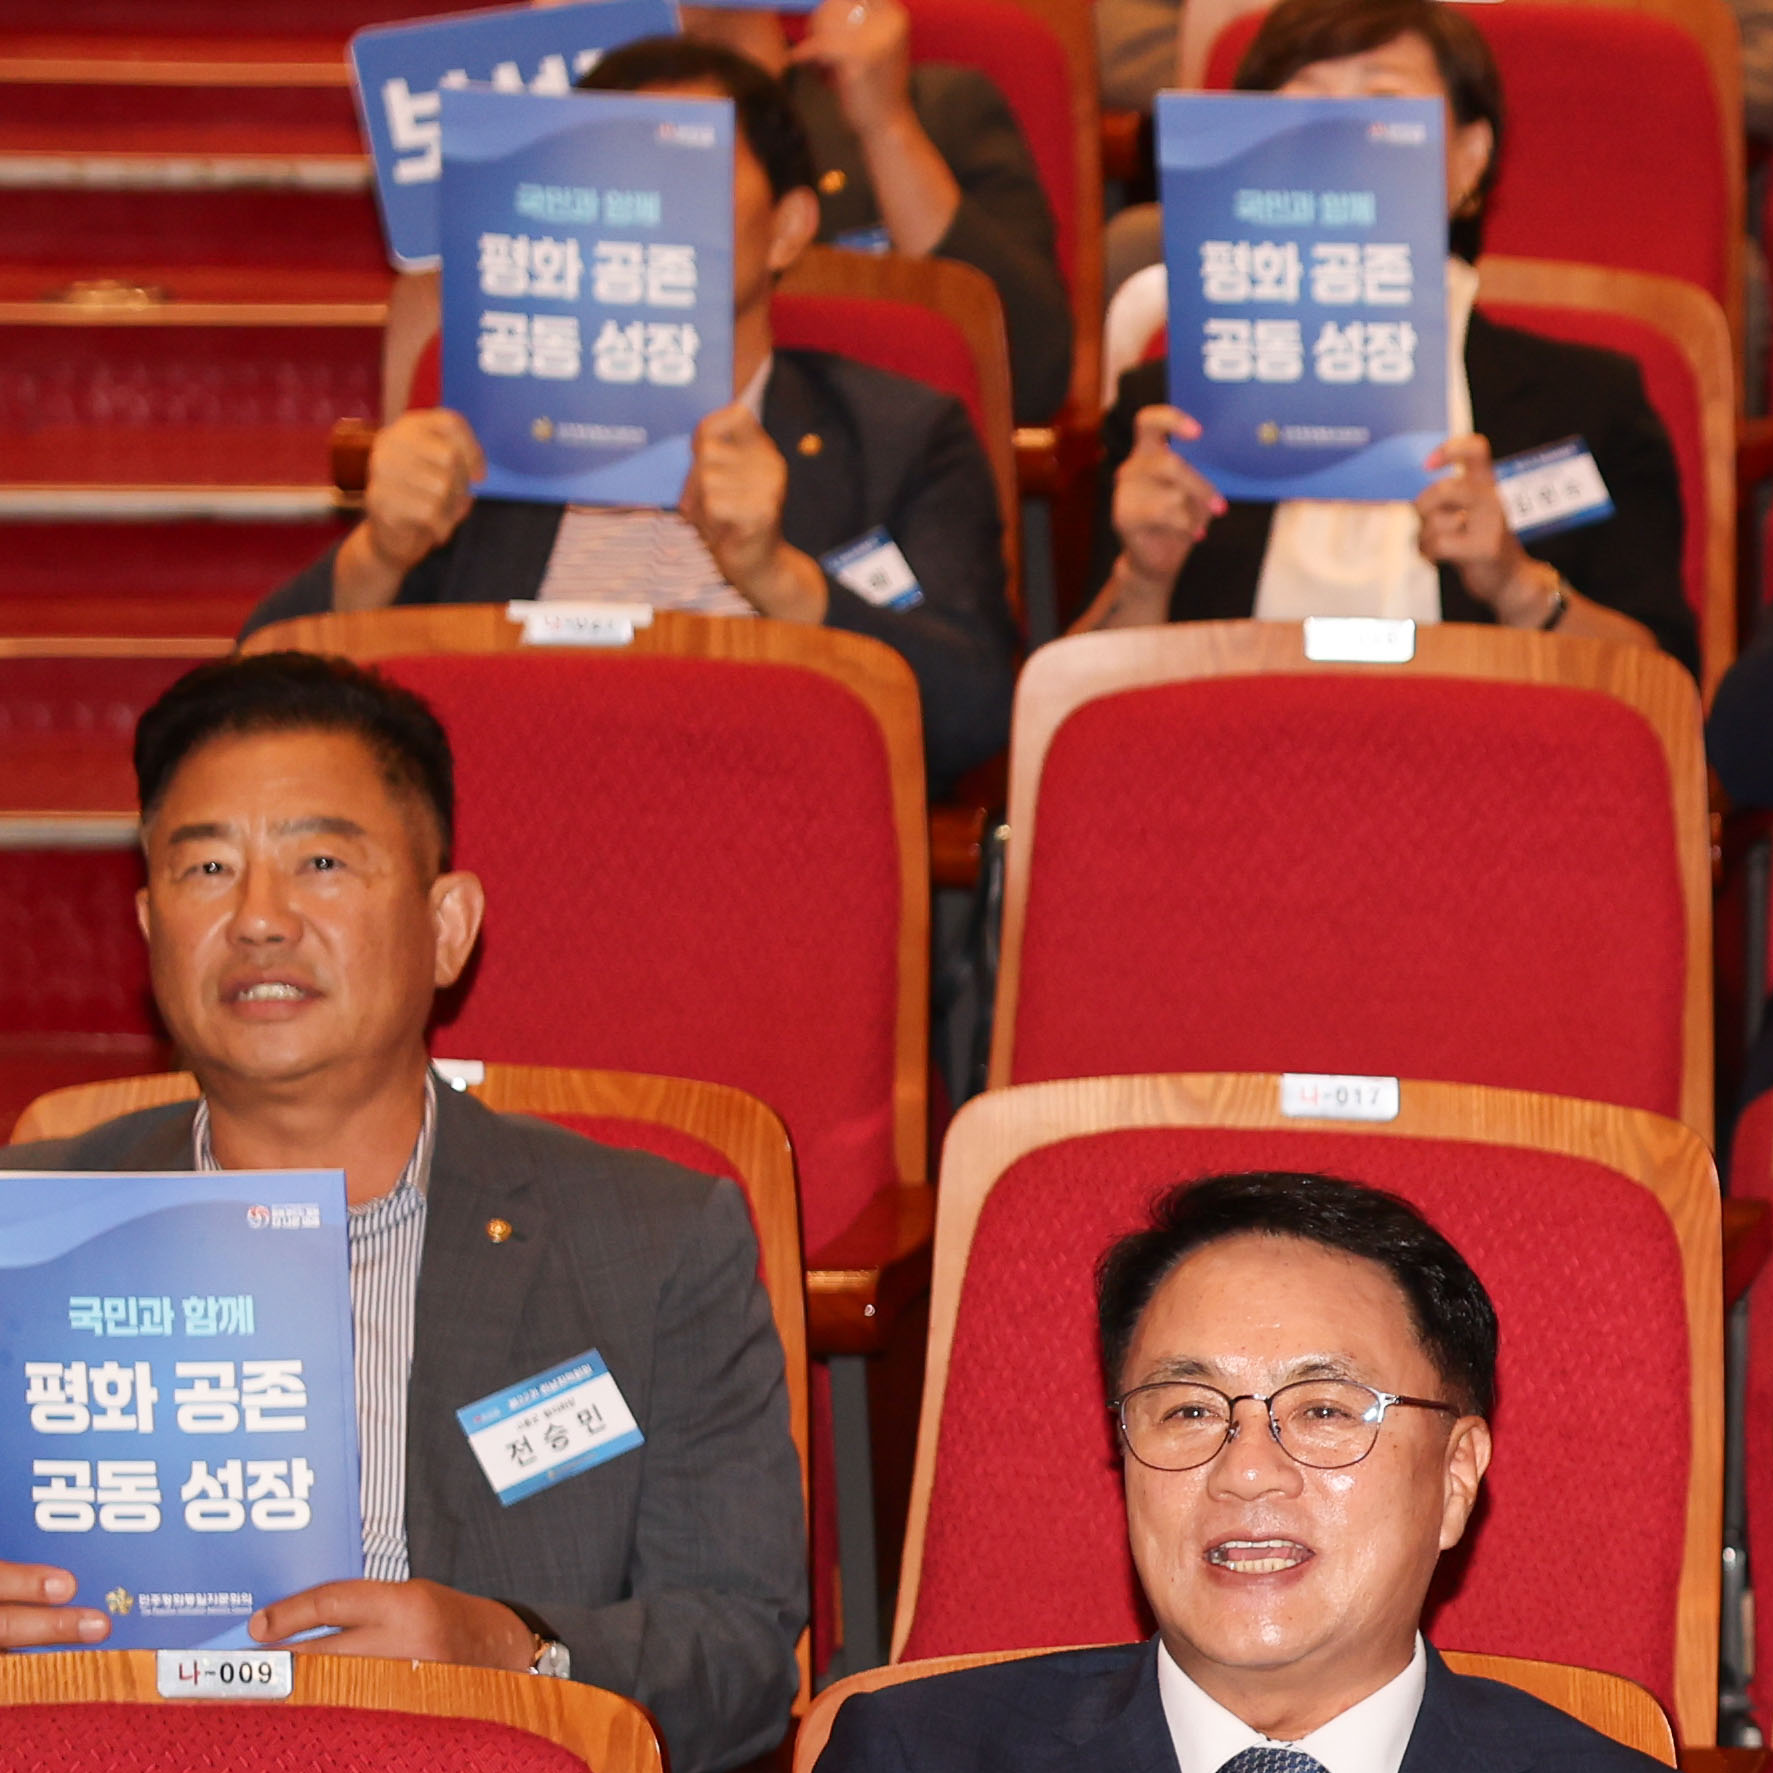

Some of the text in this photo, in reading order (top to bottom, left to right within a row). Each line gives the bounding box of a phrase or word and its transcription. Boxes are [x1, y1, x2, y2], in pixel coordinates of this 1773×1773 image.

[480, 235, 696, 307] 평화 공존
[1202, 242, 1412, 304] 평화 공존
[594, 321, 699, 384] 성장
[1315, 322, 1417, 382] 성장
[69, 1295, 254, 1336] 국민과 함께
[26, 1360, 307, 1433] 평화 공존
[33, 1458, 314, 1531] 공동 성장
[179, 1659, 273, 1686] 나-009
